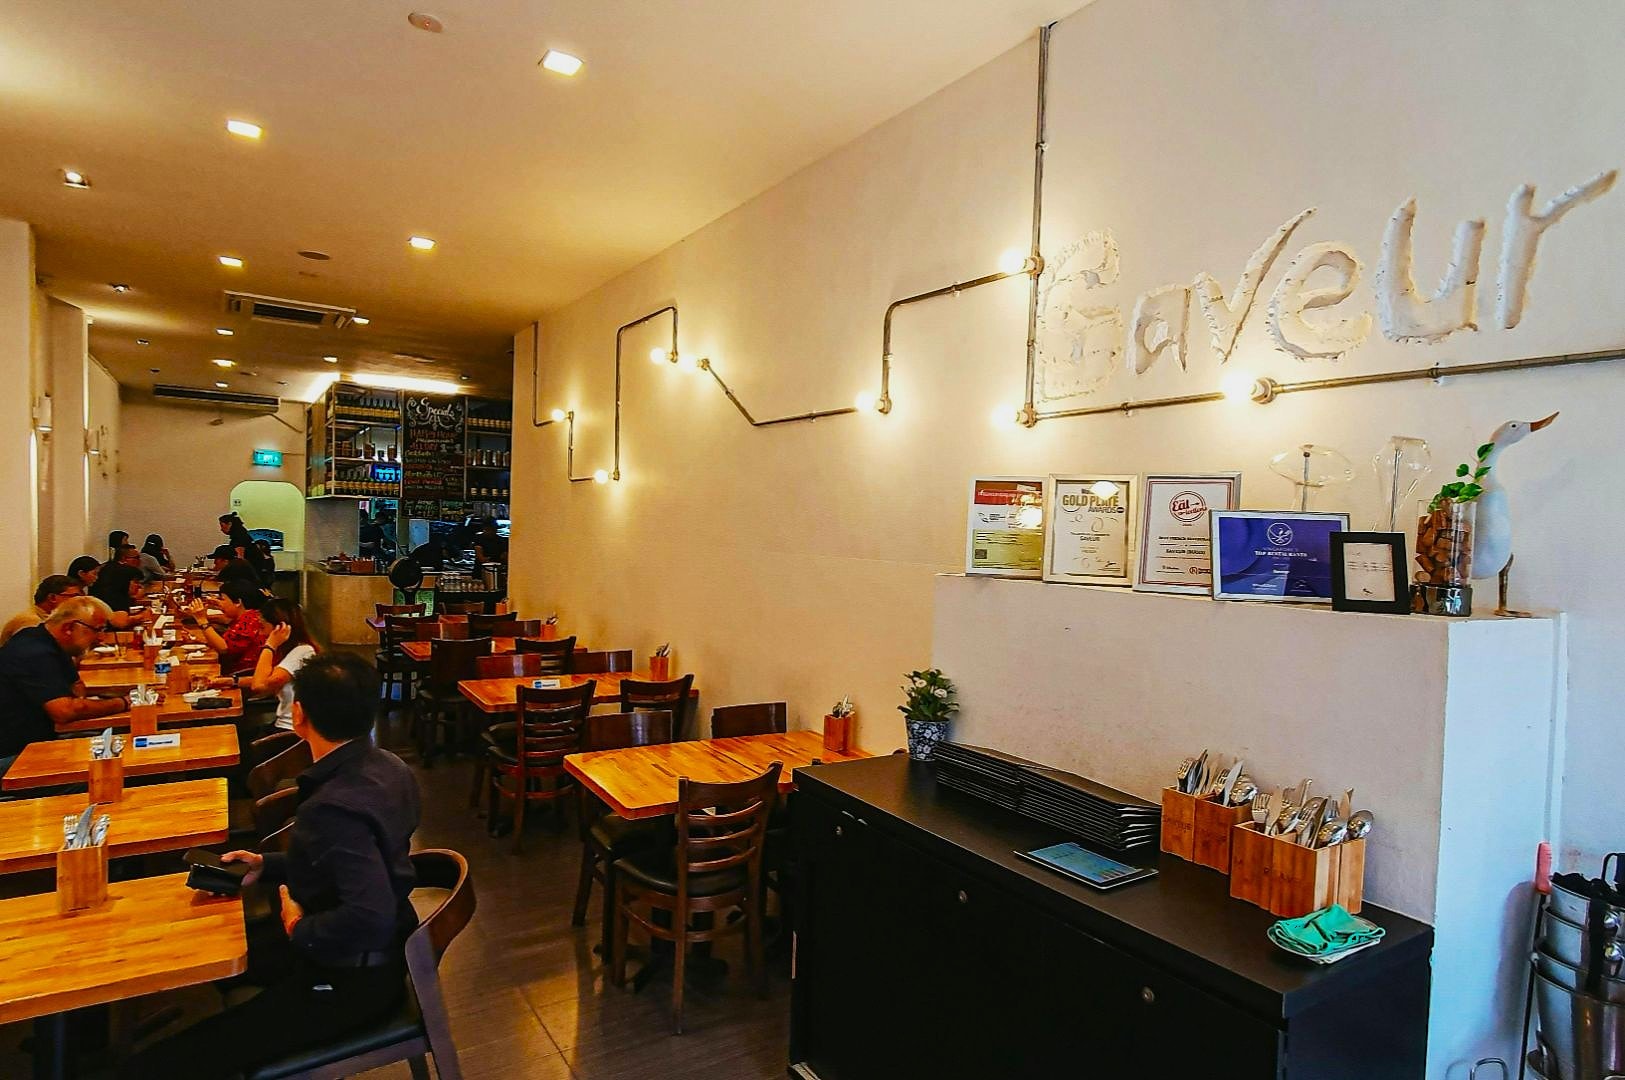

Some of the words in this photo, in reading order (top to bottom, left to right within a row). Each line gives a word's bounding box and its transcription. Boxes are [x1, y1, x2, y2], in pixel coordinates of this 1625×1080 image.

[415, 397, 455, 421] Specials
[1062, 494, 1088, 506] GOLD
[1172, 499, 1190, 512] Eat
[1088, 506, 1116, 514] AWARDS
